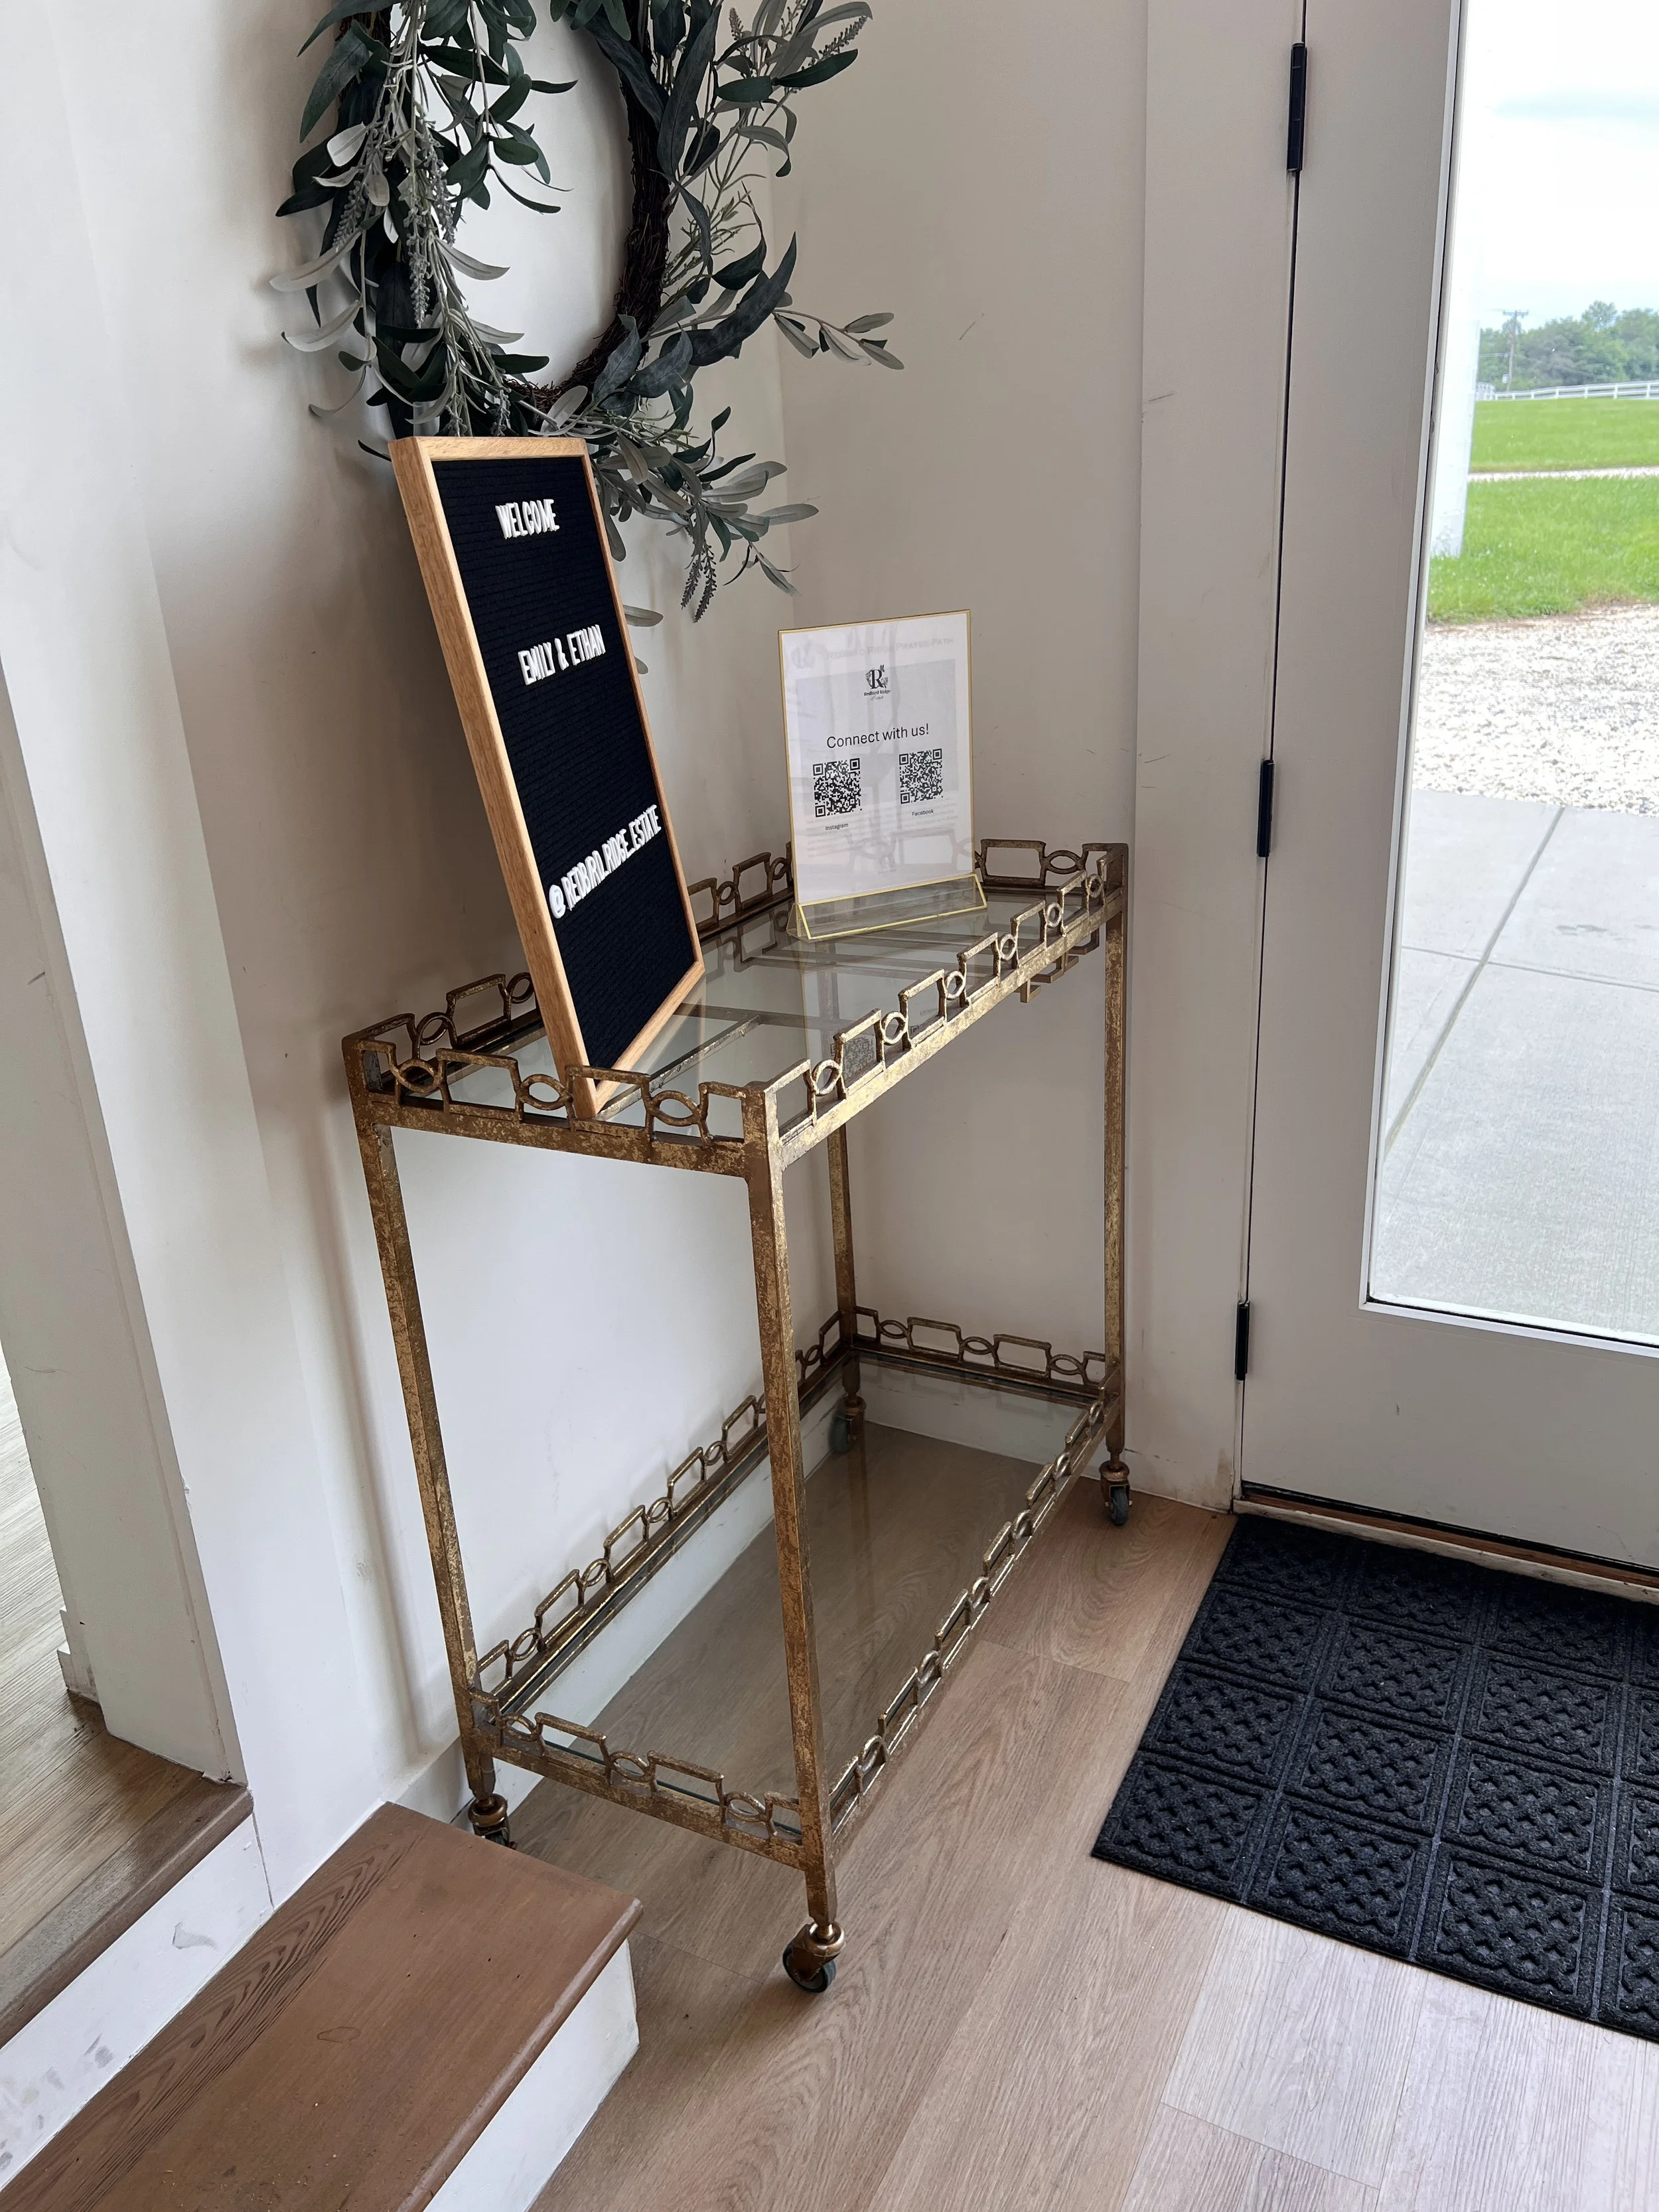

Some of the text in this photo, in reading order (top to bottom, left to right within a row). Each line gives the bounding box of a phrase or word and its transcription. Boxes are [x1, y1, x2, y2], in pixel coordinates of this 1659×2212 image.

[495, 499, 559, 539] WELCOME
[518, 625, 606, 686] EMILY & ETHAN
[827, 723, 929, 749] Connect with us!
[911, 808, 934, 817] Facebook
[825, 822, 849, 831] Instagram
